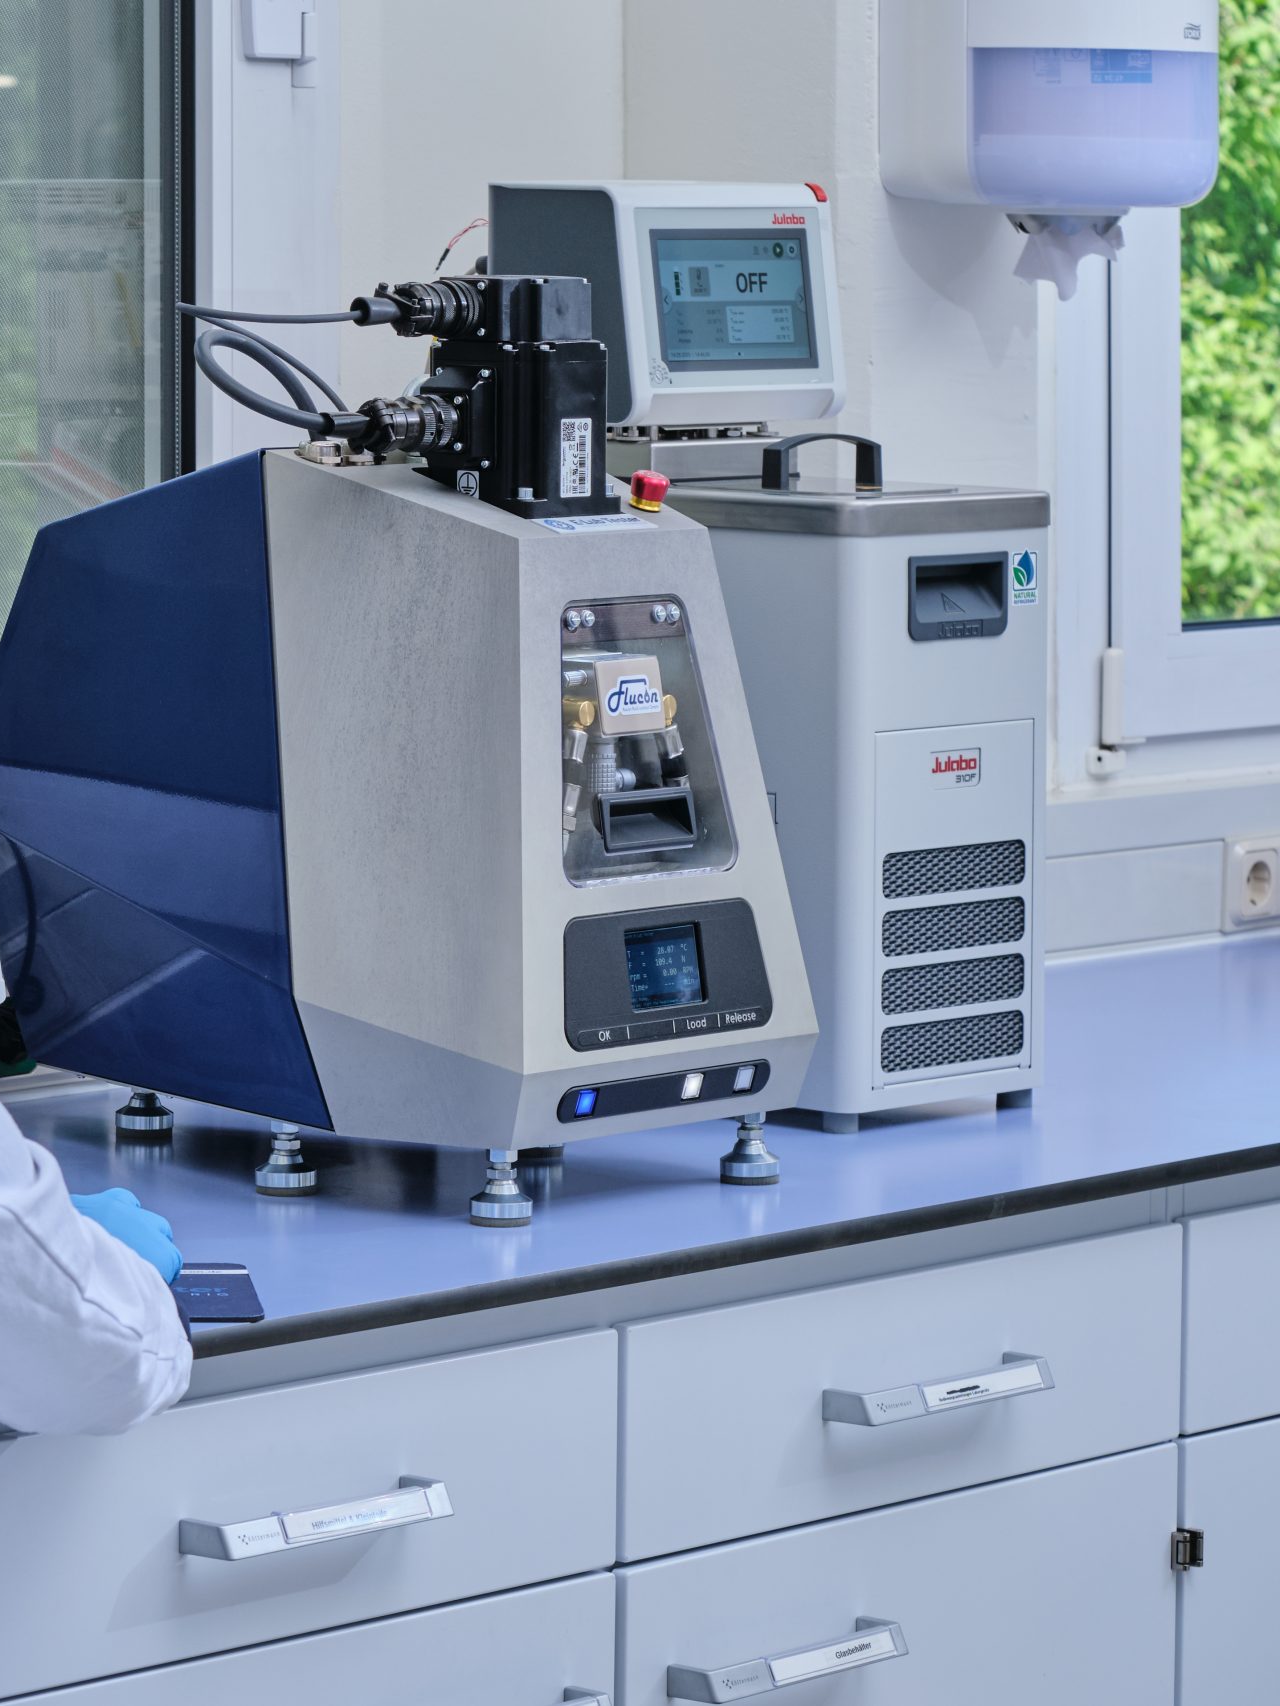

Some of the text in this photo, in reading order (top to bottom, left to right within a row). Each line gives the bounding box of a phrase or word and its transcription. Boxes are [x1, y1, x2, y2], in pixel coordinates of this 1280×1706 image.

[771, 213, 805, 225] Julabo
[736, 272, 768, 293] OFF
[1014, 591, 1036, 599] NATURAL
[608, 678, 659, 713] Flucon
[931, 754, 977, 774] Julabo
[955, 773, 976, 783] 310F
[598, 1010, 757, 1042] OK Load Release
[835, 1641, 872, 1660] Glasbehälter
